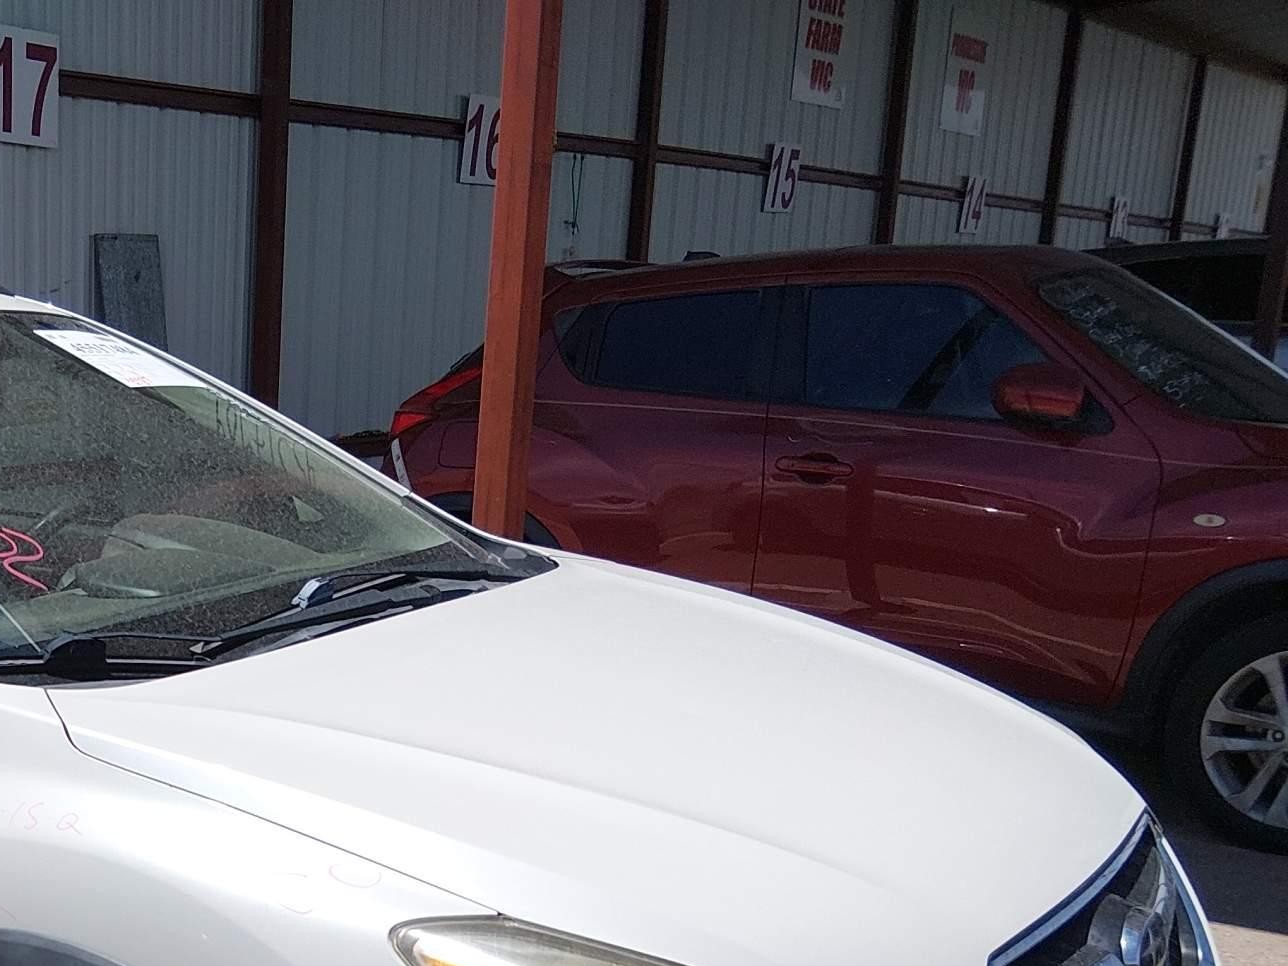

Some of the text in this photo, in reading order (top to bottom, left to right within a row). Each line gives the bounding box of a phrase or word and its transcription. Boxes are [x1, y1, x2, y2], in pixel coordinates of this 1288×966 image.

[805, 17, 843, 55] FARM
[770, 146, 800, 209] 15
[964, 178, 987, 230] 14
